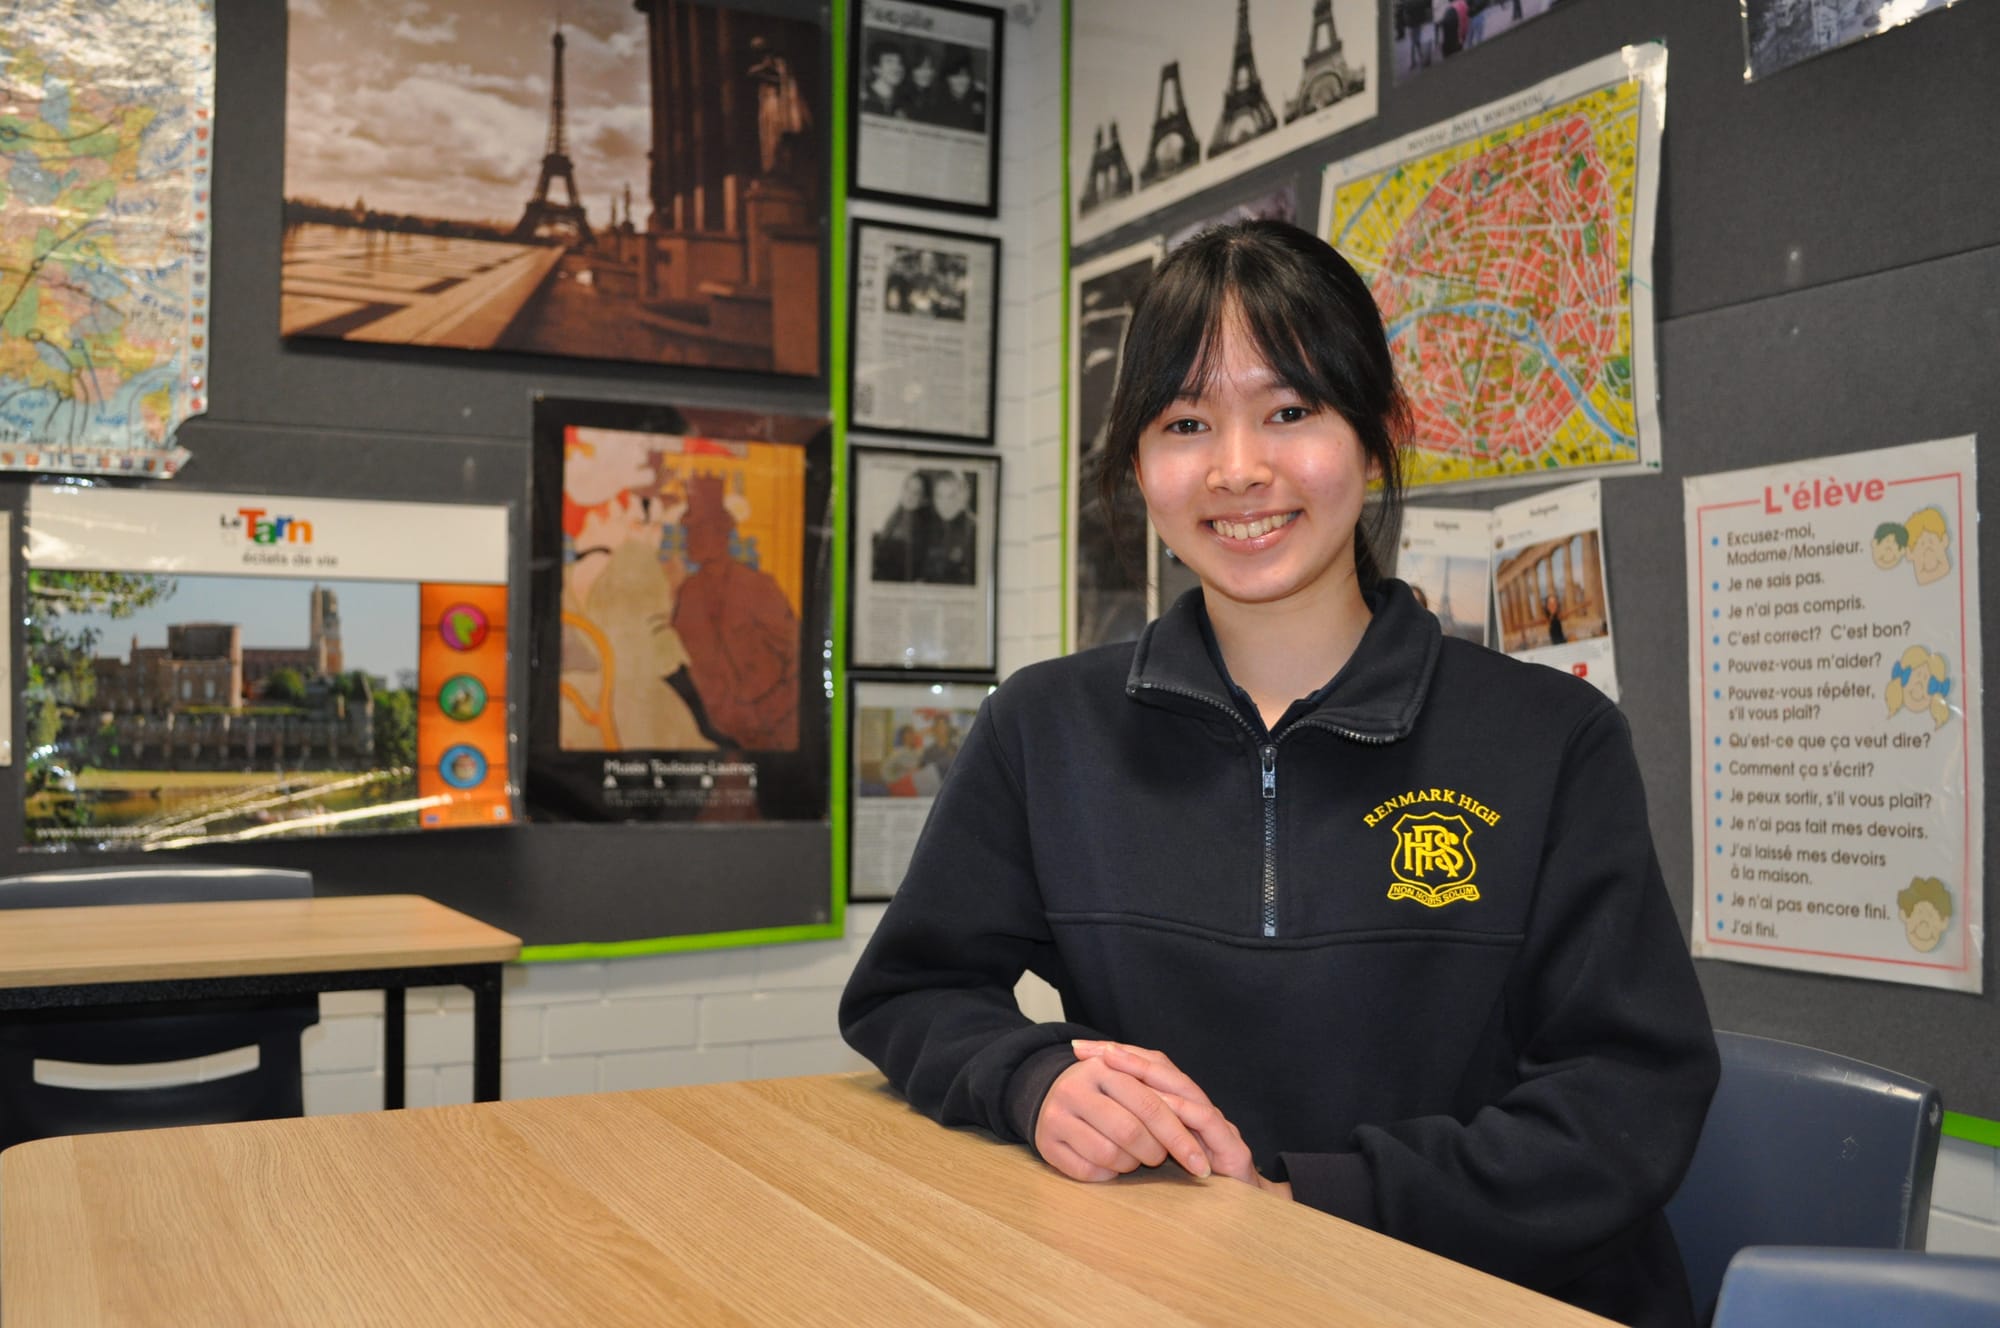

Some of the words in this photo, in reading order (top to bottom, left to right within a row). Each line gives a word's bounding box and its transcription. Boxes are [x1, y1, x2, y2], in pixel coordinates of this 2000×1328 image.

[1764, 477, 1885, 514] L'élève
[237, 507, 313, 544] Tarn
[1727, 524, 1815, 545] Excusez-moi,
[291, 552, 313, 567] de
[1727, 540, 1863, 566] Madame/Monsieur.
[1728, 577, 1742, 592] Je
[1746, 576, 1763, 590] ne
[1767, 571, 1791, 588] sais
[1795, 571, 1824, 592] pas.
[1728, 604, 1742, 619] Je
[1746, 602, 1770, 618] n'ai
[1774, 601, 1799, 621] pas
[1803, 597, 1865, 619] compris.
[1728, 629, 1760, 646] C'est
[1764, 626, 1821, 644] correct?
[1830, 624, 1868, 642] C'est
[1872, 621, 1911, 638] bon?
[1728, 656, 1813, 673] Pouvez-vous
[1817, 652, 1882, 670] m'aider?
[1729, 686, 1813, 700] Pouvez-vous
[1817, 682, 1875, 704] répéter,
[1729, 705, 1744, 721] s'il
[1748, 705, 1778, 720] vous
[1729, 733, 1793, 749] Qu'est-ce
[1798, 735, 1826, 752] que
[1831, 735, 1850, 750] ça
[1855, 732, 1888, 749] veut
[1892, 733, 1931, 749] dire?
[1729, 760, 1795, 776] Comment
[1799, 764, 1818, 780] ça
[1822, 762, 1874, 778] s'écrit?
[1363, 788, 1456, 828] RENMARK
[1458, 793, 1501, 827] HIGH
[1729, 789, 1743, 804] Je
[1747, 792, 1781, 808] peux
[1785, 790, 1822, 808] sortir,
[1826, 791, 1845, 807] s'il
[1849, 794, 1885, 808] vous
[1730, 817, 1744, 831] Je
[1747, 816, 1772, 831] n'ai
[1776, 821, 1801, 836] pas
[1804, 819, 1827, 834] fait
[1832, 823, 1863, 836] mes
[1867, 823, 1928, 839] devoirs.
[1730, 844, 1751, 858] J'ai
[1755, 843, 1792, 861] laissé
[1796, 850, 1827, 864] mes
[1831, 849, 1886, 867] devoirs
[1731, 865, 1739, 880] à
[1742, 865, 1755, 880] la
[1758, 869, 1812, 885] maison.
[1393, 886, 1414, 896] NON
[1442, 887, 1474, 903] SOLUM
[1731, 892, 1744, 907] Je
[1748, 894, 1773, 909] n'ai
[1777, 898, 1802, 914] pas
[1807, 901, 1860, 917] encore
[1864, 901, 1890, 919] fini.
[1731, 922, 1752, 936] J'ai
[1755, 922, 1778, 937] fini.
